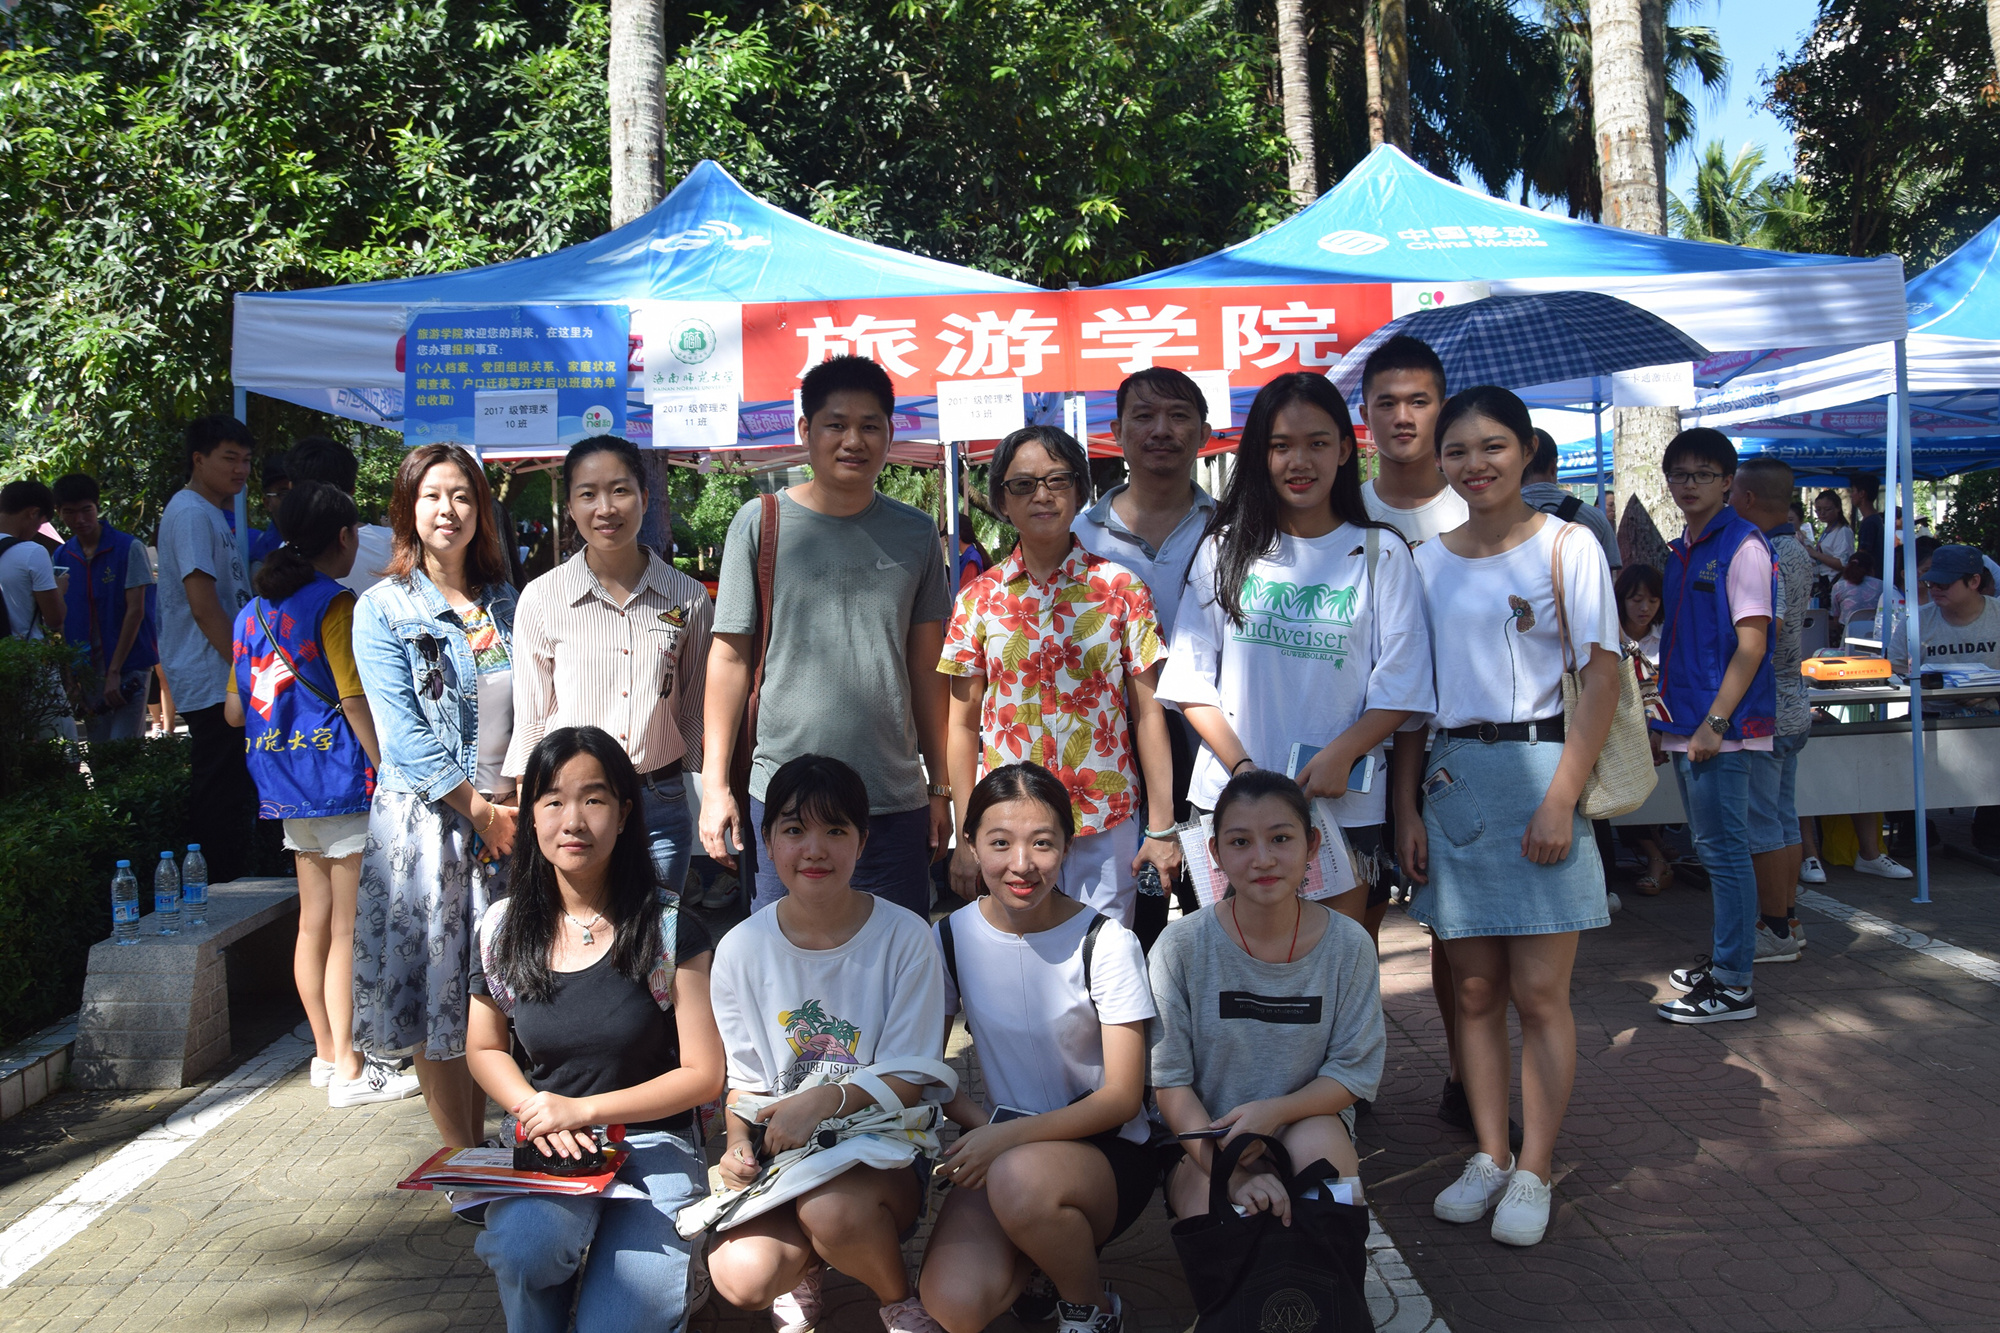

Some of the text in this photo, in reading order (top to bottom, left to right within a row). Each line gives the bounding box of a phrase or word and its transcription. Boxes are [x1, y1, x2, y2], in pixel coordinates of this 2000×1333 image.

[1397, 225, 1540, 242] 中国移动
[1406, 239, 1548, 250] China Mobile
[796, 301, 1342, 379] 旅游学院
[484, 405, 549, 416] 2017 级管理类
[663, 404, 728, 413] 2017 级管理类
[506, 420, 528, 428] 10 班
[685, 418, 707, 426] 11 班
[1926, 641, 1997, 657] HOLIDAY
